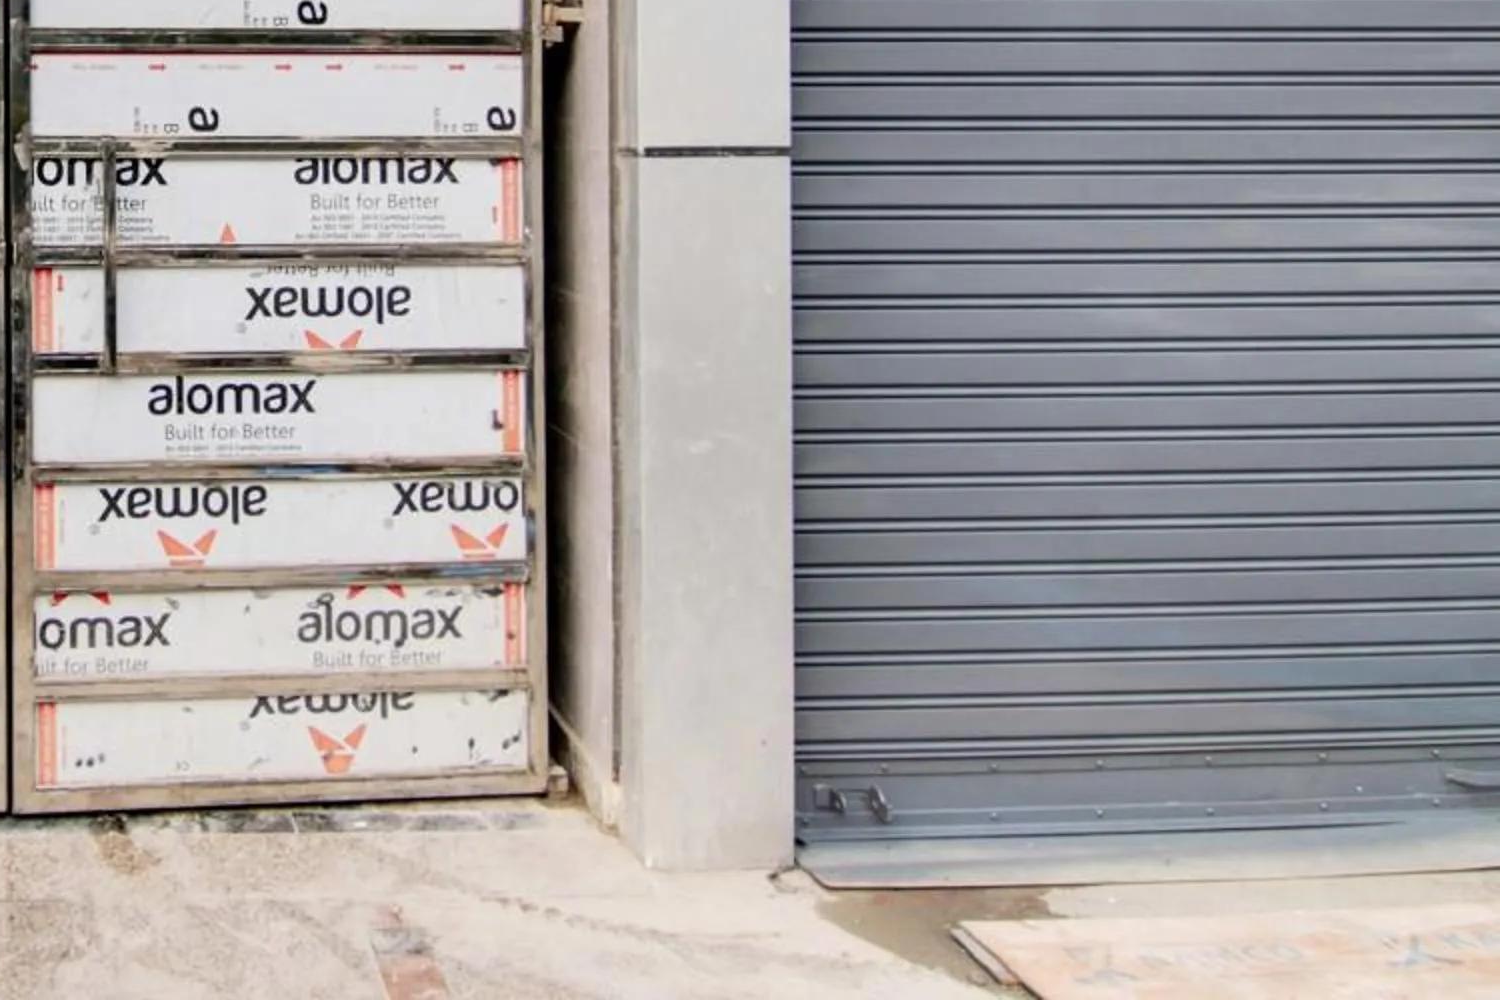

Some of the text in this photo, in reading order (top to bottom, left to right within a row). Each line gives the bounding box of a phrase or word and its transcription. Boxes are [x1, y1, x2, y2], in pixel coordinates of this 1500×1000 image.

[310, 193, 440, 210] Built for Better
[244, 283, 411, 324] alomax
[147, 376, 317, 416] alomax
[164, 423, 296, 441] Built for Better
[98, 485, 267, 526] alomax
[393, 480, 520, 517] omax
[39, 611, 171, 649] omax
[297, 604, 463, 648] alomax
